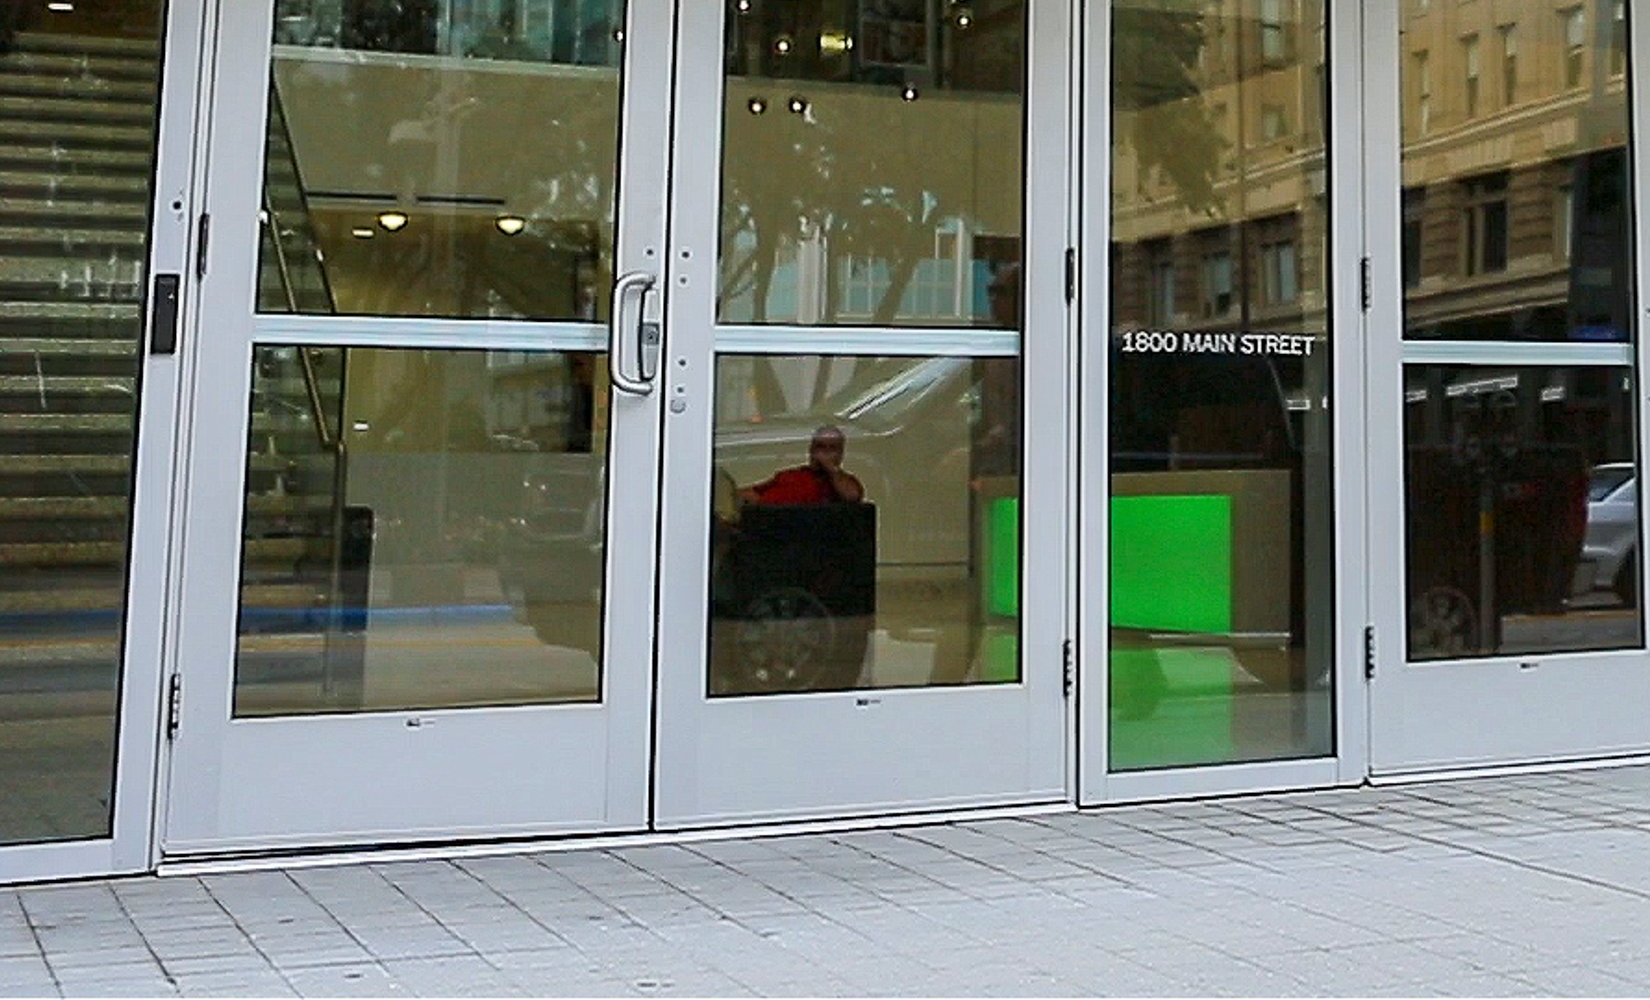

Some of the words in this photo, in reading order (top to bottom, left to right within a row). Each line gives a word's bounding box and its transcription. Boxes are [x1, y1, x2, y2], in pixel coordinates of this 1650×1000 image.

[1122, 331, 1178, 353] 1800
[1182, 333, 1236, 353] MAIN
[1240, 334, 1316, 356] STREET
